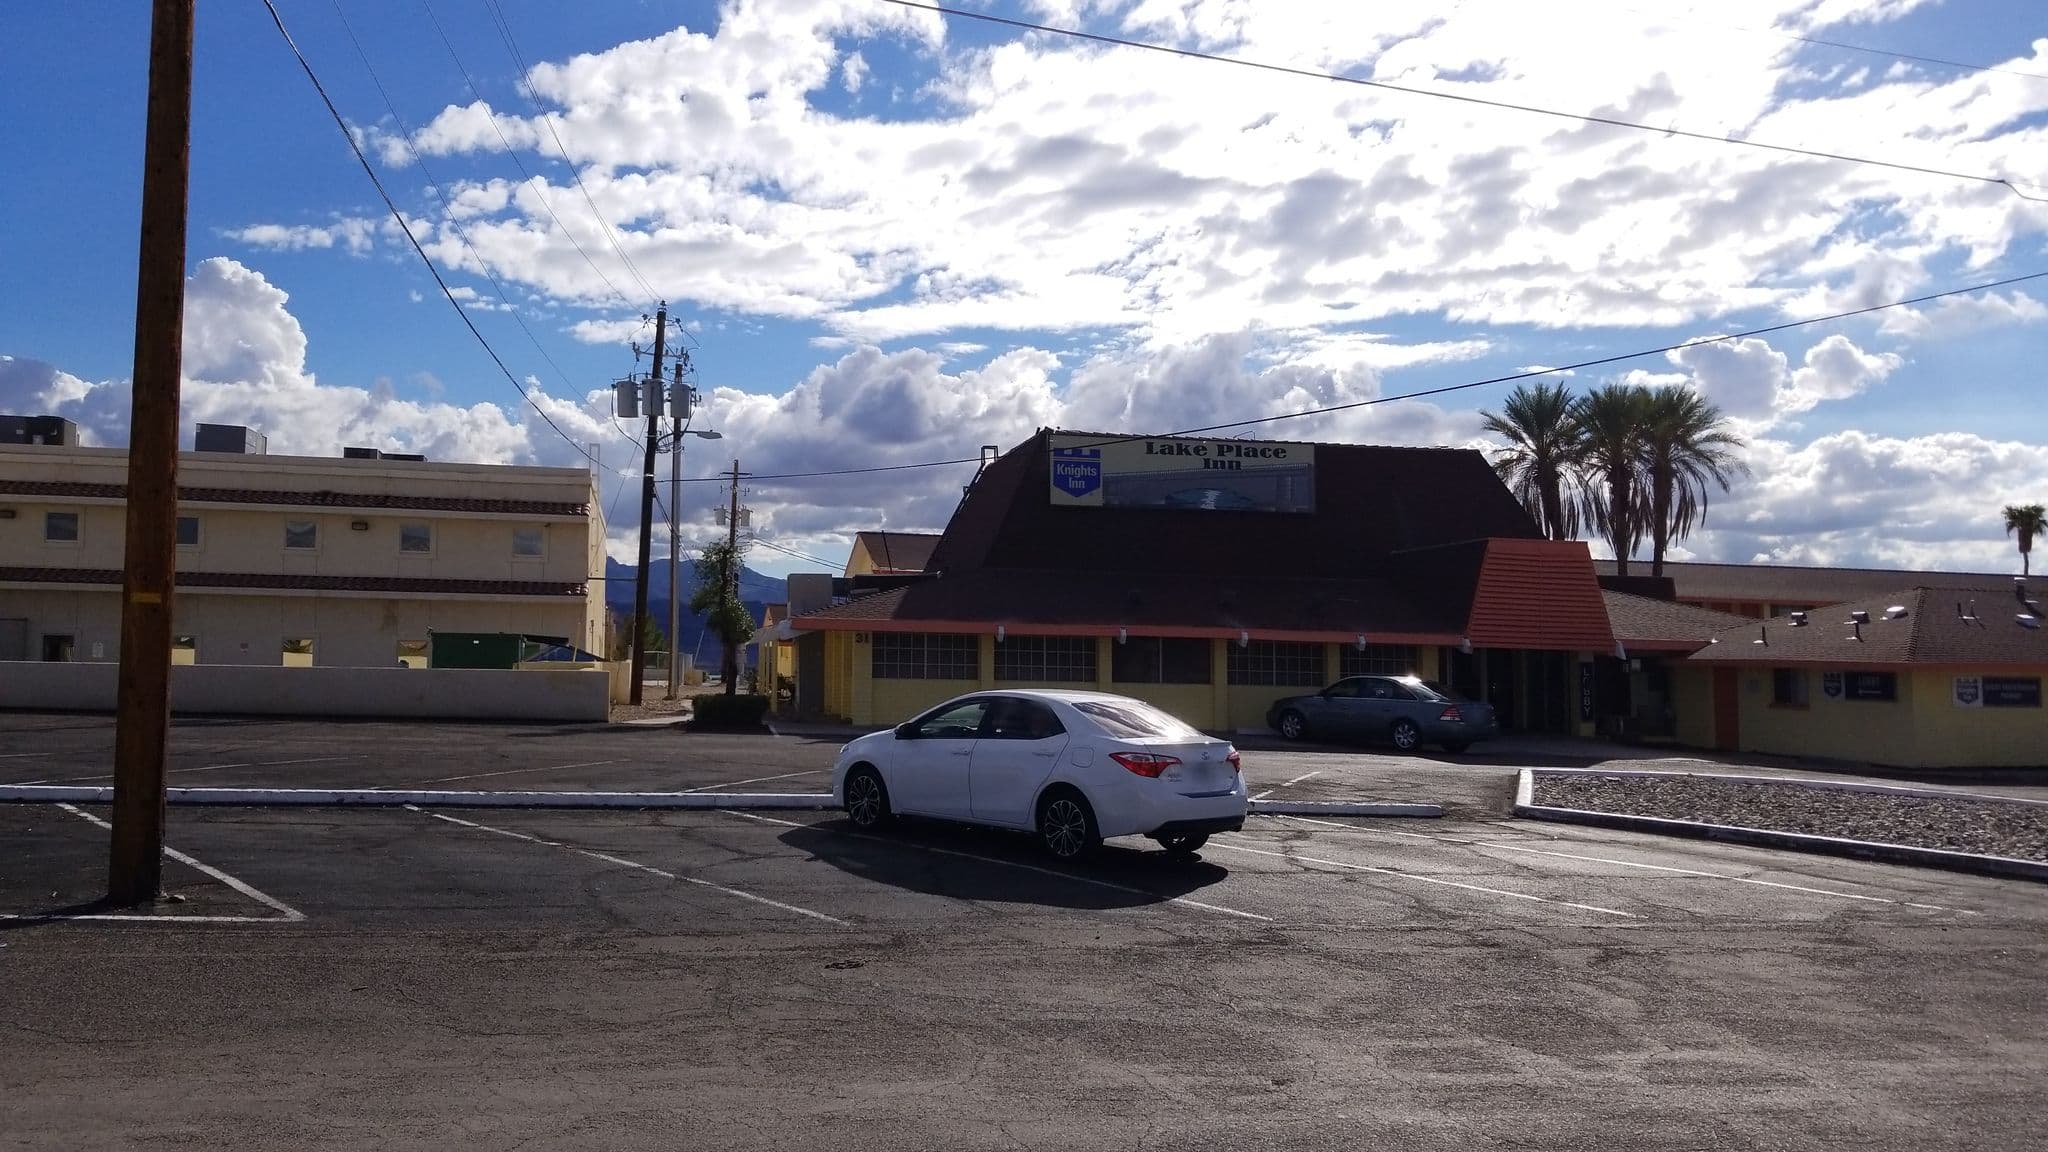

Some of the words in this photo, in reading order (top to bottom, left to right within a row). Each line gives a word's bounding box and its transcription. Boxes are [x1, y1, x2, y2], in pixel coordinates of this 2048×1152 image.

[1145, 441, 1207, 457] Lake
[1216, 443, 1288, 459] Place
[1056, 463, 1097, 478] Knights
[1202, 458, 1242, 471] Inn
[1068, 477, 1086, 489] Inn
[855, 632, 869, 643] 31
